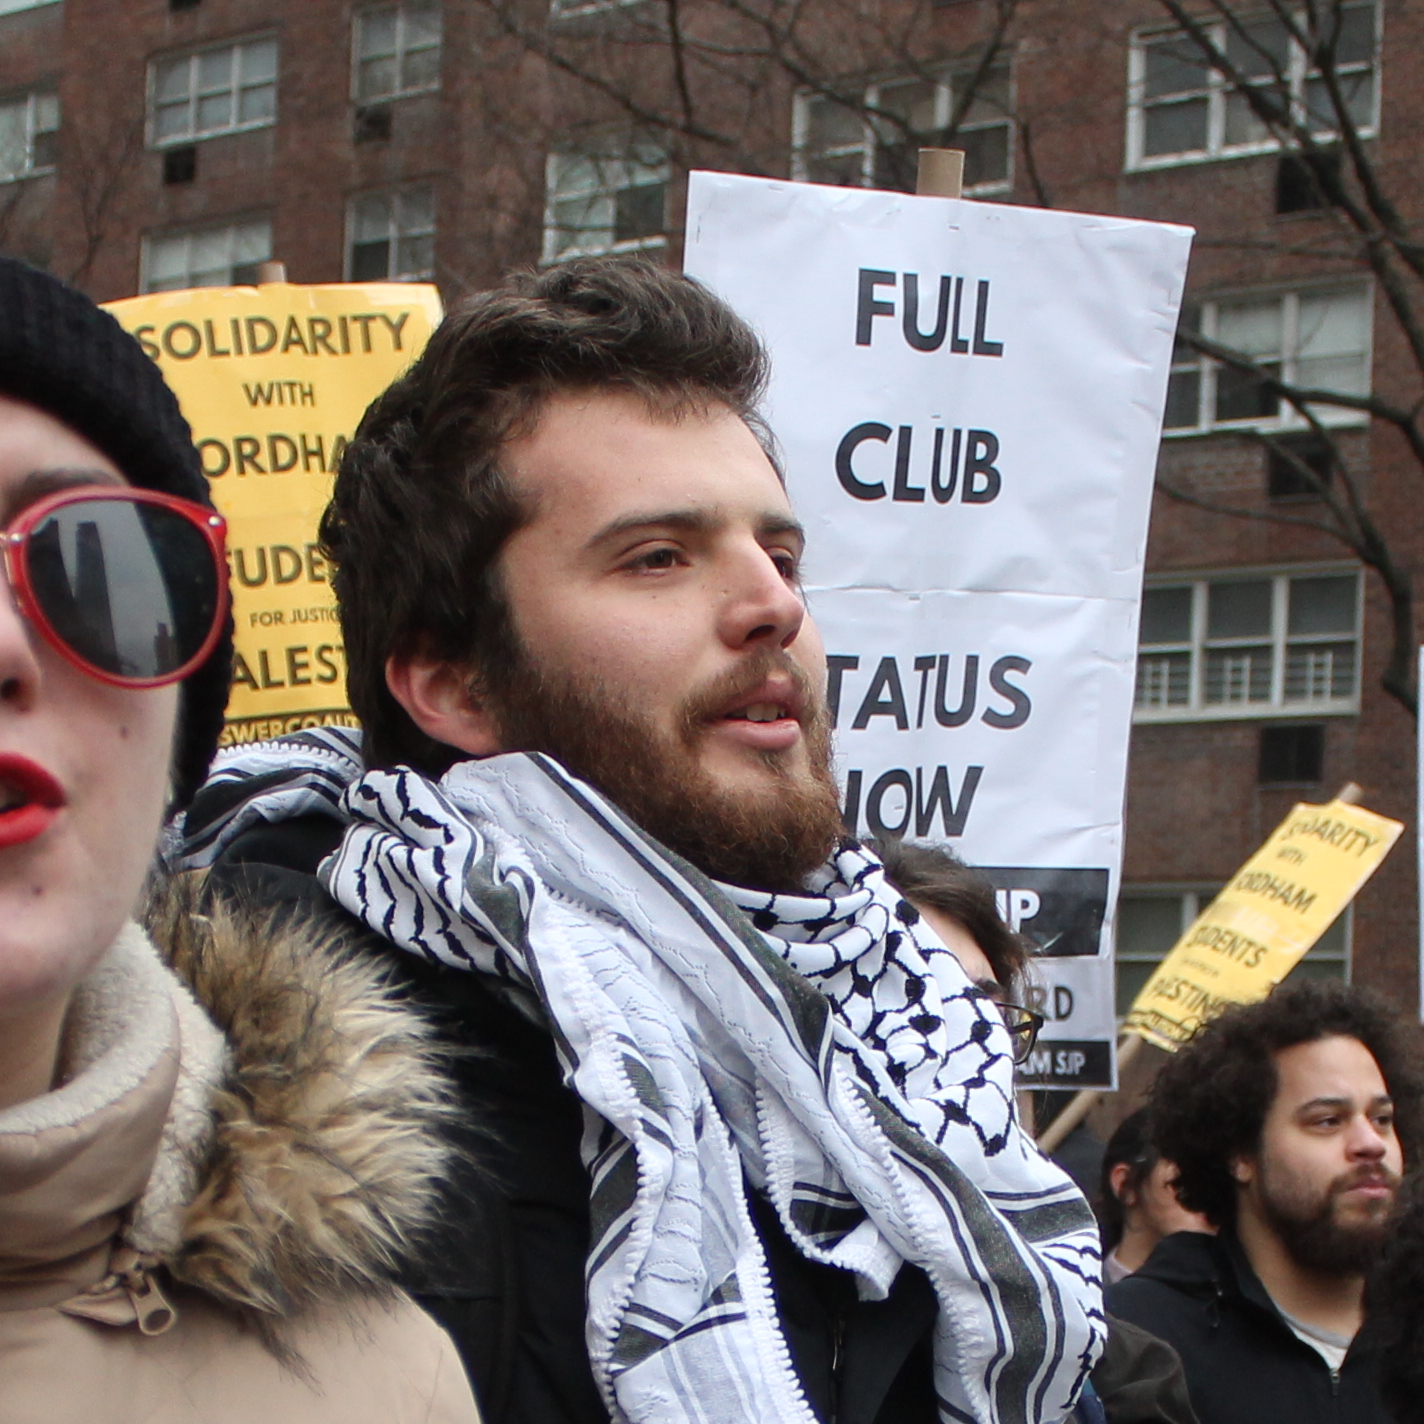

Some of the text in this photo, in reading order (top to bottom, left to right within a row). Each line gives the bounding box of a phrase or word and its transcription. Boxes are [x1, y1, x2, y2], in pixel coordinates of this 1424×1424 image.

[854, 267, 1004, 358] FULL
[137, 312, 410, 364] SOLIDARITY
[243, 380, 316, 408] WITH
[195, 433, 349, 478] ORDHA
[834, 421, 1003, 505] CLUB
[249, 607, 342, 628] FOR JUSTIC
[826, 654, 1033, 731] TATUS
[1054, 1052, 1086, 1076] SJP
